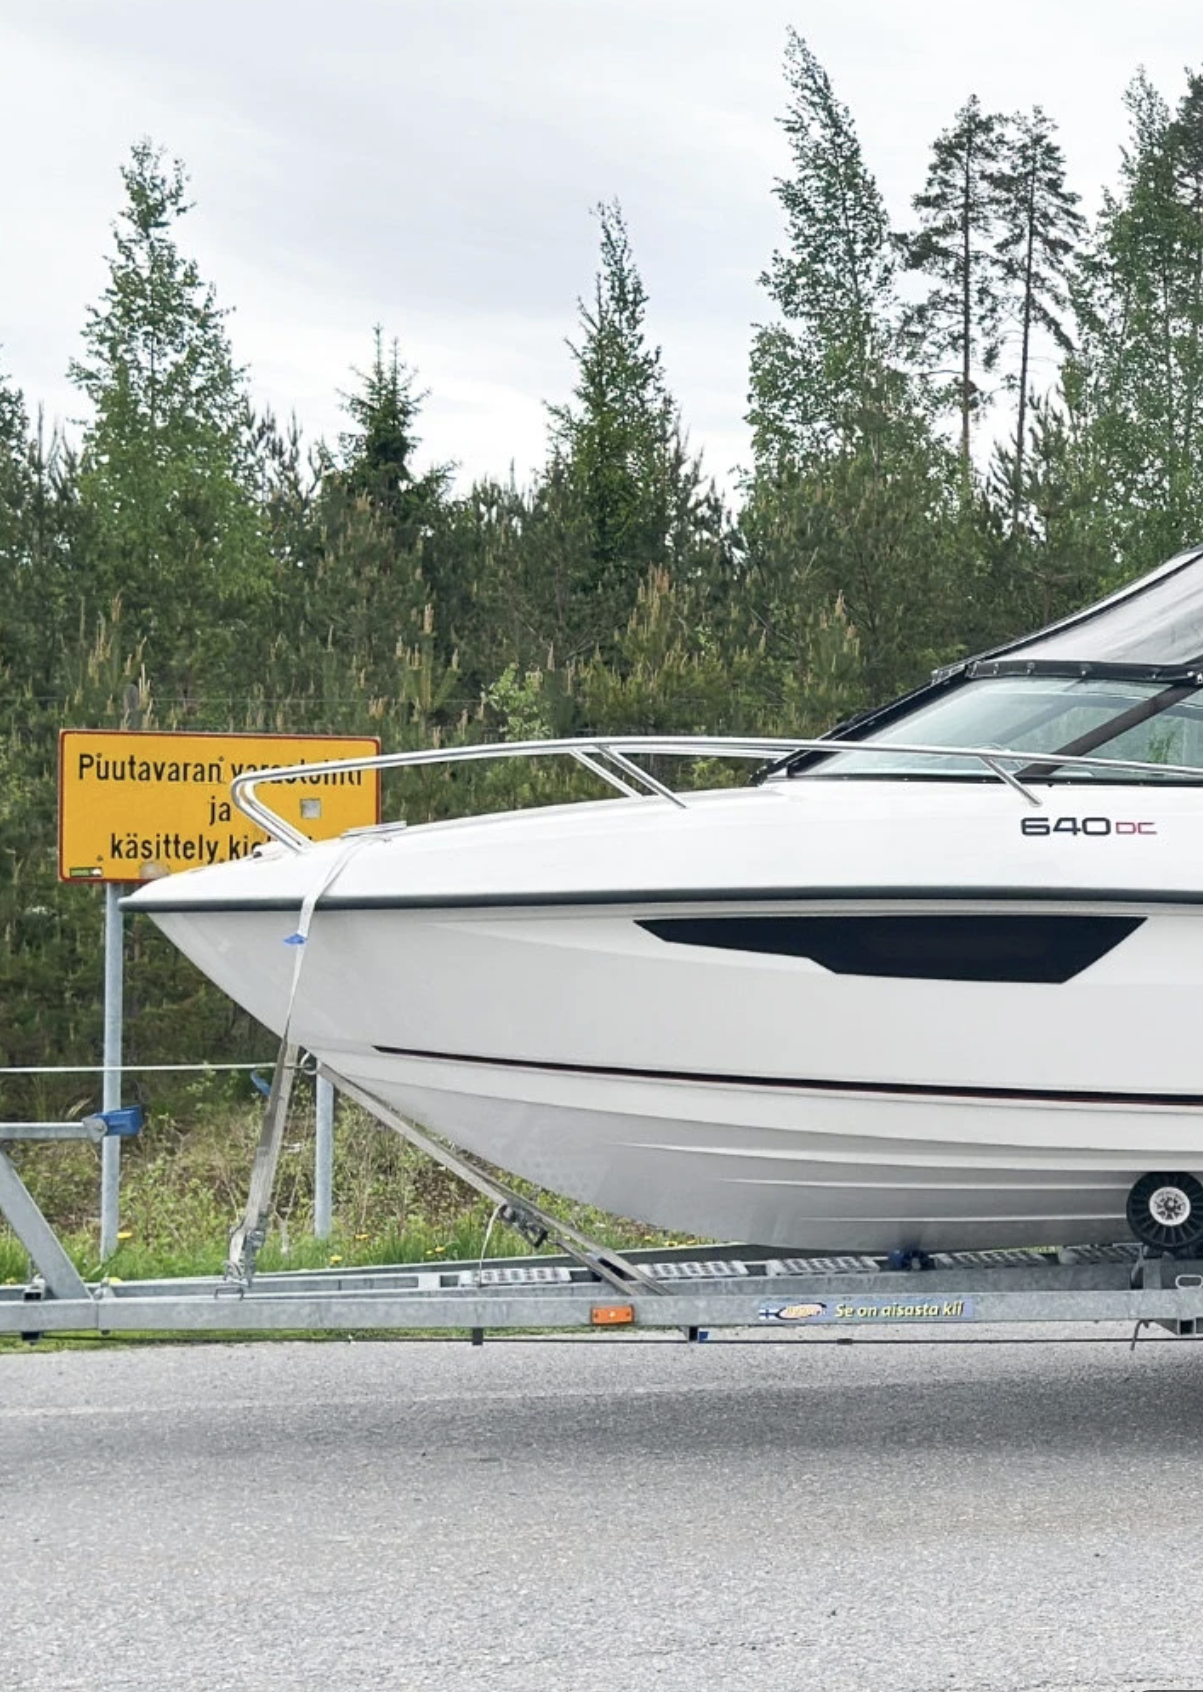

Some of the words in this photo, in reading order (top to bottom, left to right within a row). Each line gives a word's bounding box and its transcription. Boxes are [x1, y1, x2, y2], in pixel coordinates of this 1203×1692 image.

[79, 753, 222, 779] Puutavaran
[230, 758, 362, 786] vtointi
[209, 795, 231, 826] ja
[1021, 817, 1111, 836] 640
[1115, 822, 1158, 834] DC
[111, 832, 219, 865] käsittely
[835, 1303, 854, 1318] Se
[857, 1306, 878, 1318] on
